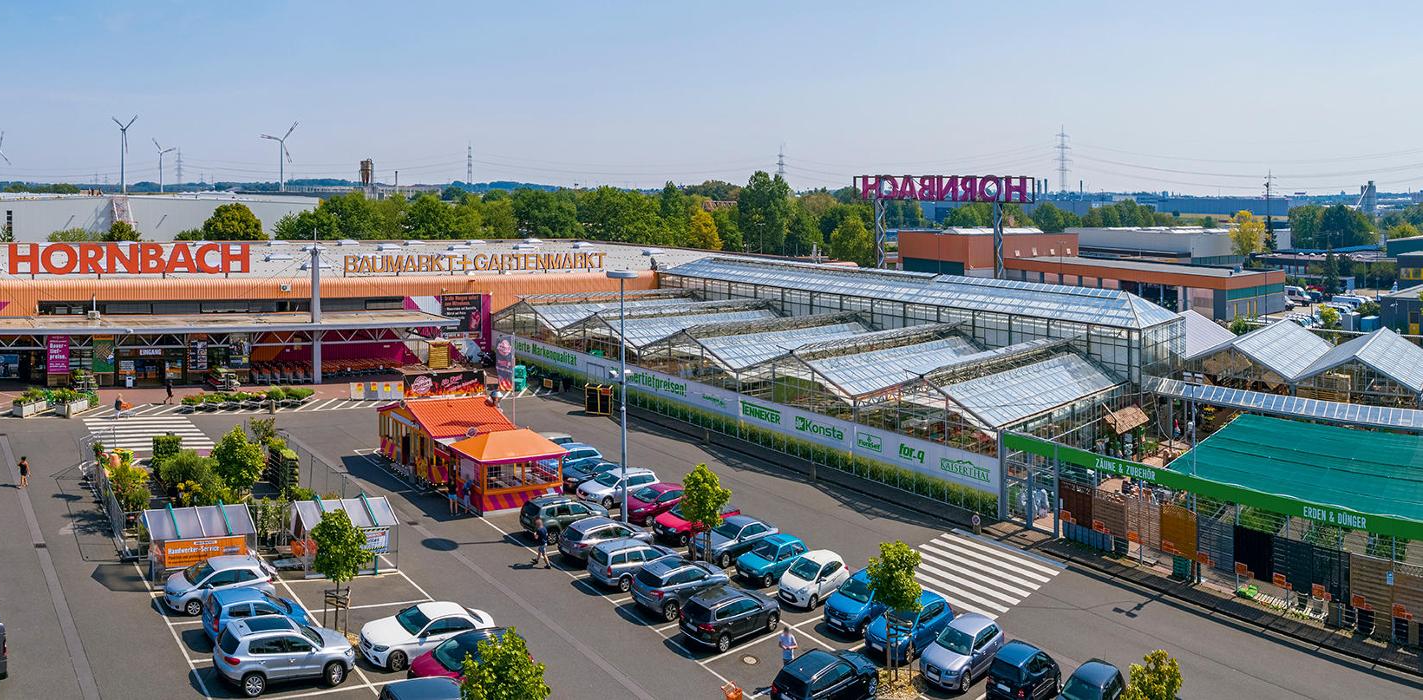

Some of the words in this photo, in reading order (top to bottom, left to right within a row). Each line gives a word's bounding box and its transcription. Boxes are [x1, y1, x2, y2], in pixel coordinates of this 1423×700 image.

[8, 243, 250, 275] HORNBACH
[740, 400, 781, 424] TENNEKER
[805, 420, 844, 440] Konsta
[1096, 458, 1116, 472] ZÄUNE
[1118, 463, 1124, 474] &
[1126, 465, 1156, 481] ZUBEHÖR
[1303, 506, 1326, 521] ERDEN
[1329, 511, 1335, 523] &
[1338, 512, 1367, 529] DÜNGER
